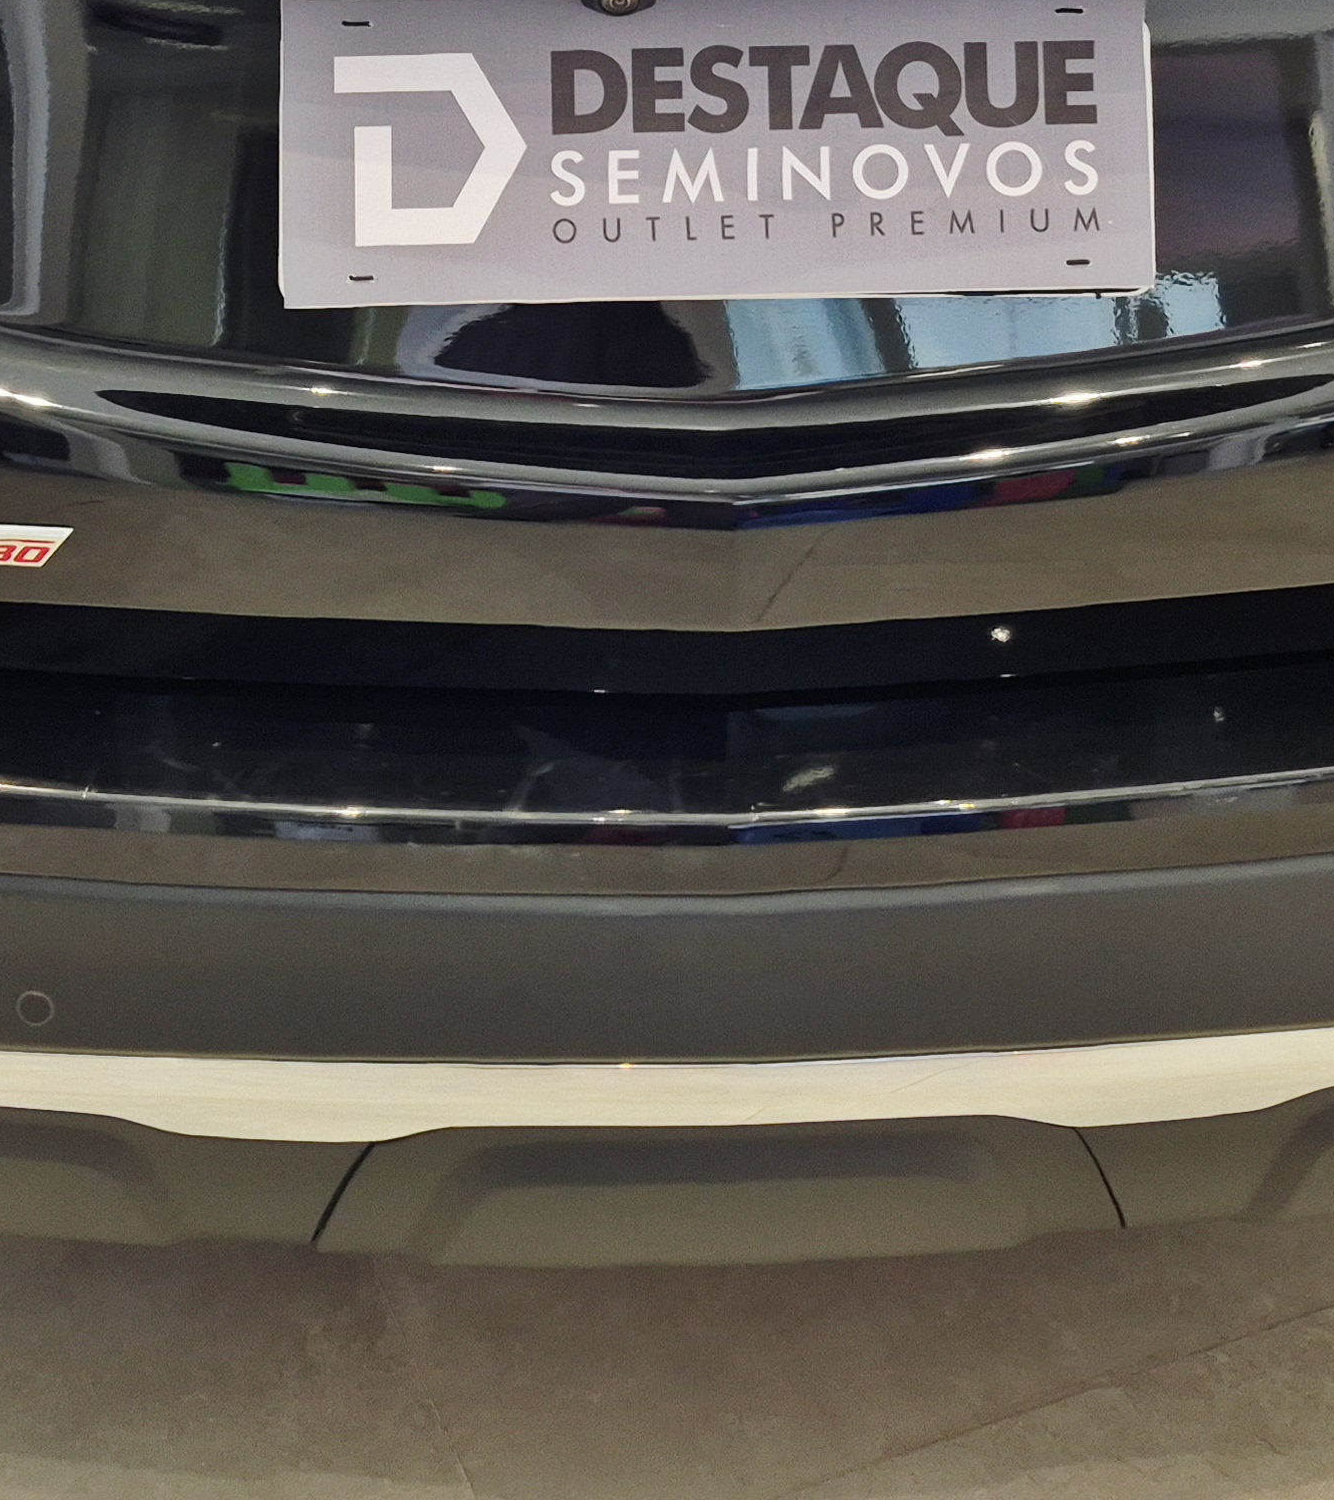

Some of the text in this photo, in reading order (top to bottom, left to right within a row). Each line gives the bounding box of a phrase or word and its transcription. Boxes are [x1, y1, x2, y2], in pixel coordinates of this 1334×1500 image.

[550, 39, 1098, 137] DESTAQUE
[549, 139, 1101, 208] SEMINOVOS
[552, 207, 1102, 245] OUTLET PREMIUM
